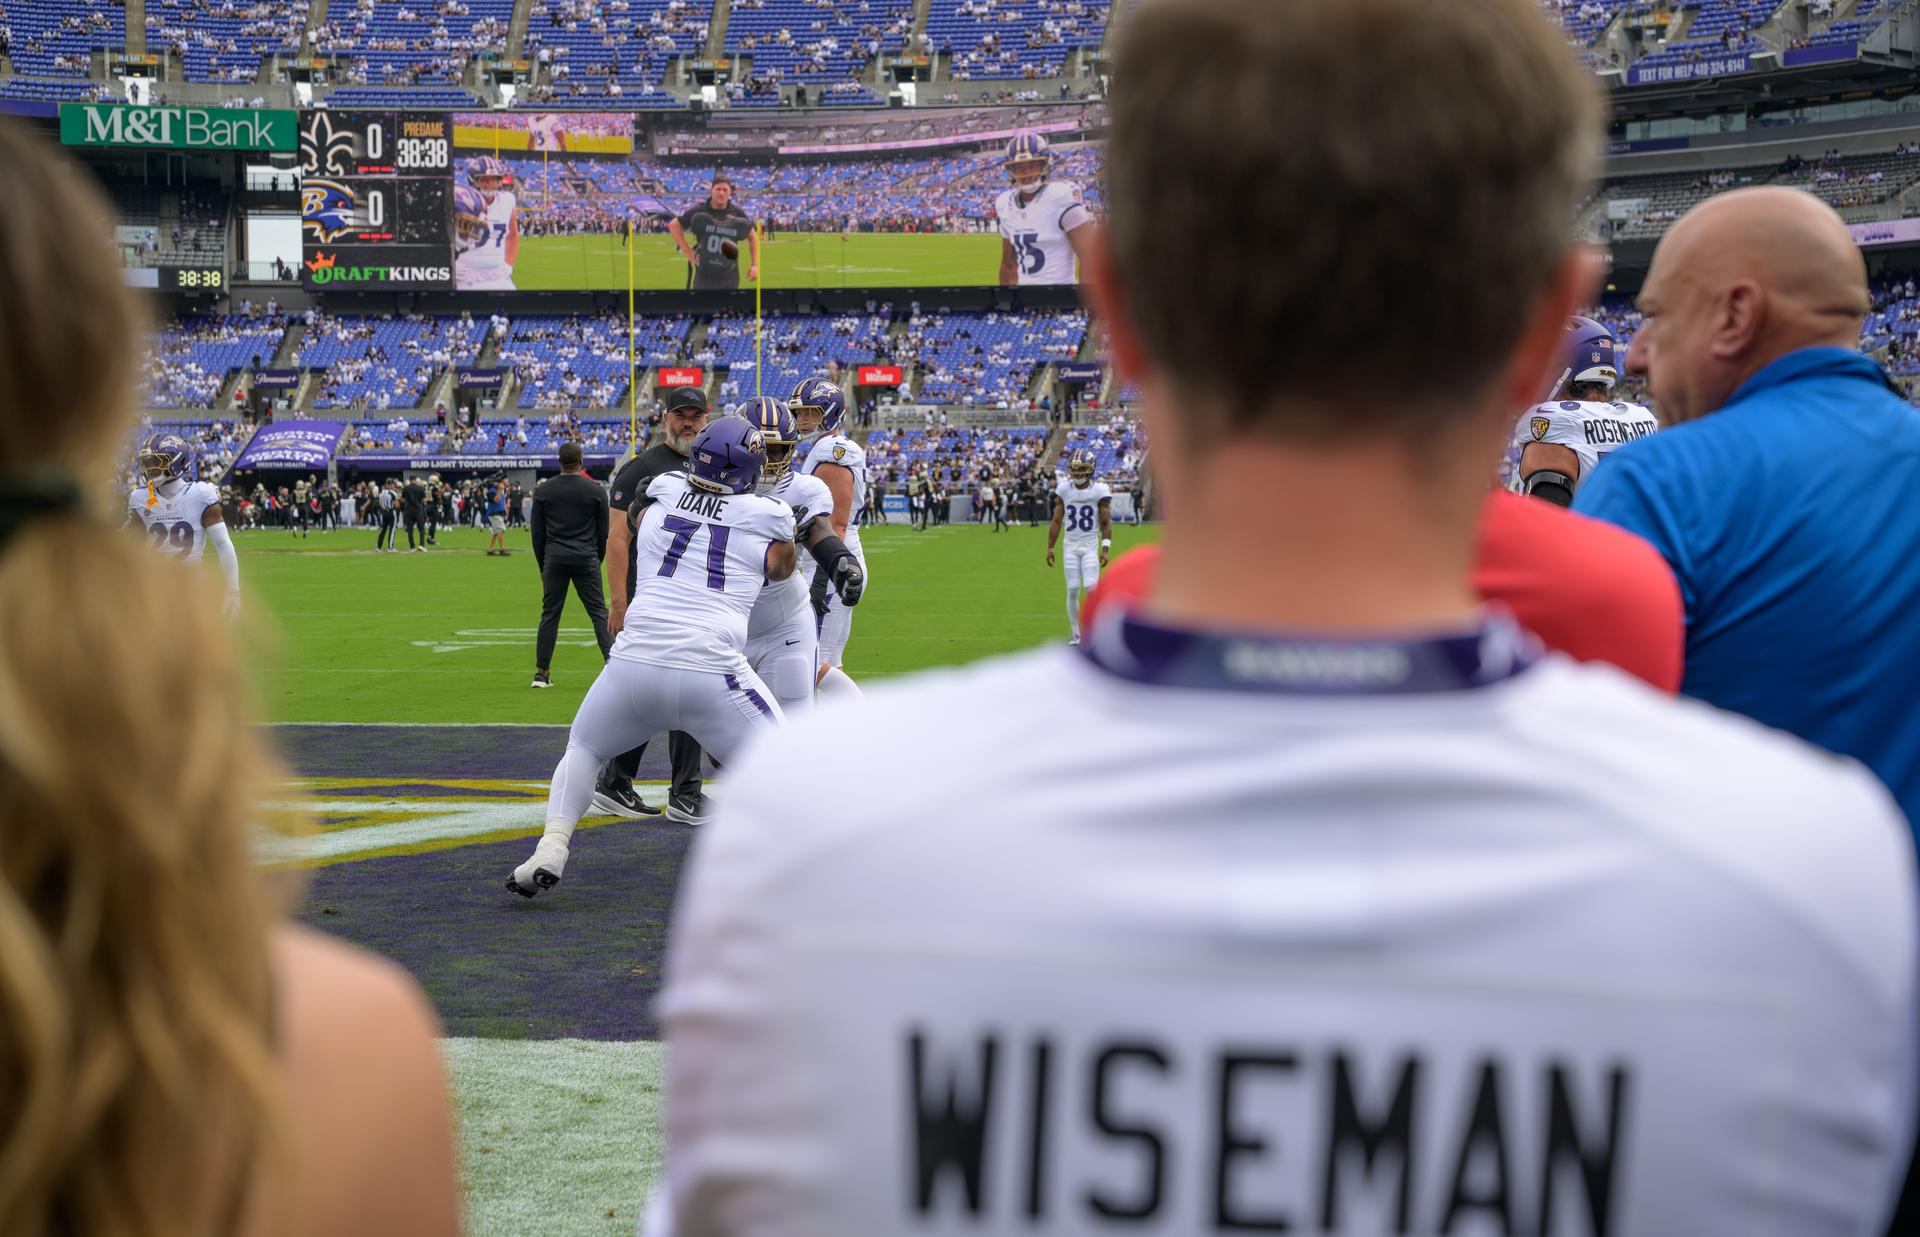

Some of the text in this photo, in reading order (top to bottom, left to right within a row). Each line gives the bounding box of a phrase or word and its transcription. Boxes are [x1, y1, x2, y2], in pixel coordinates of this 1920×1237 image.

[1640, 69, 1656, 81] TEXT
[1658, 67, 1673, 80] FOR
[1674, 64, 1694, 79] HELP
[83, 106, 275, 147] M&T Bank
[367, 123, 383, 159] 0
[404, 122, 444, 137] PREGAME
[397, 139, 448, 168] 38:38
[368, 191, 383, 226] 0
[1013, 233, 1045, 275] 15
[178, 270, 221, 287] 38:38
[311, 265, 451, 285] DRAFTKINGS
[665, 373, 695, 385] Wawa
[865, 371, 894, 383] Wawa
[411, 460, 542, 469] BUD LIGHT TOUCHDOWN CLUB
[675, 491, 729, 522] IOANE
[1066, 504, 1094, 533] 38
[656, 514, 731, 592] 71
[908, 1030, 1634, 1237] WISEMAN
